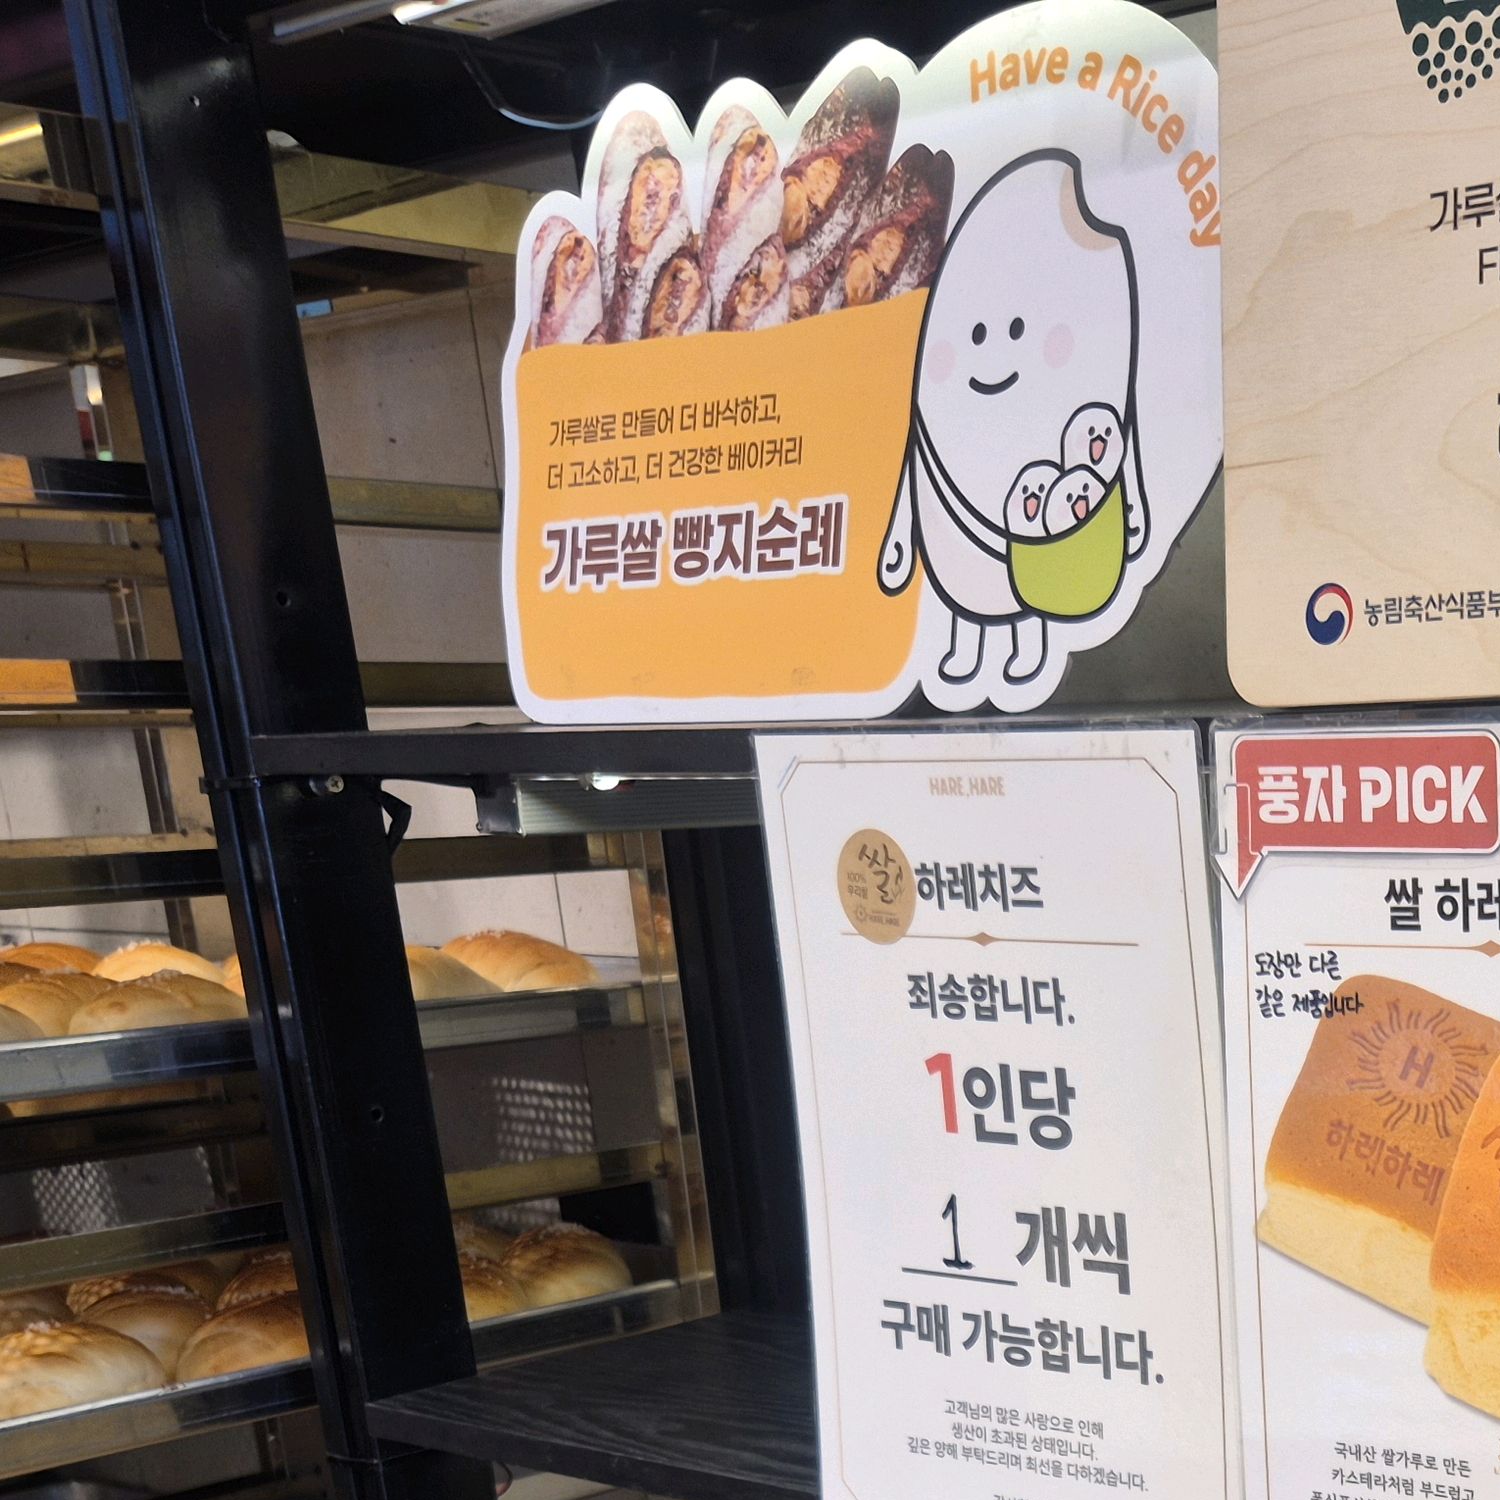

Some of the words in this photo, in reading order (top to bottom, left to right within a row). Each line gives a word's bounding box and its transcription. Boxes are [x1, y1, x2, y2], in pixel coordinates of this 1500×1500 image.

[970, 46, 1069, 103] Have
[1078, 55, 1101, 87] a
[1107, 54, 1186, 154] Rice
[1177, 149, 1221, 248] day
[549, 411, 617, 447] 가루쌀로
[621, 403, 675, 439] 만들어
[680, 405, 698, 433] 더
[702, 393, 781, 430] 바삭하고,
[547, 462, 564, 490] 더
[566, 454, 641, 489] 고소하고,
[645, 453, 663, 480] 더
[667, 443, 722, 478] 건강한
[726, 436, 803, 474] 베이커리
[544, 521, 661, 586] 가루쌀
[673, 502, 844, 578] 빵지순례
[1257, 765, 1346, 825] 풍자
[1360, 764, 1488, 823] PICK
[914, 861, 1044, 913] 하레치즈
[1384, 876, 1423, 932] 쌀
[1255, 949, 1302, 979] 도장만
[1309, 950, 1342, 981] 다른
[907, 972, 1076, 1026] 죄송합니다.
[1255, 984, 1286, 1019] 같은
[1291, 989, 1365, 1019] 제품입니다
[1400, 1044, 1434, 1087] H
[925, 1051, 1076, 1150] 1인당
[942, 1193, 975, 1270] 1
[1015, 1206, 1132, 1296] 개씩
[880, 1298, 952, 1357] 구매
[962, 1309, 1165, 1386] 가능합니다.
[944, 1400, 993, 1421] 고객님의
[995, 1405, 1020, 1425] 많은
[1024, 1412, 1074, 1433] 사랑으로
[1077, 1418, 1104, 1439] 인해
[951, 1422, 988, 1443] 생산이
[990, 1427, 1028, 1449] 초과된
[1030, 1434, 1099, 1461] 상태입니다.
[907, 1436, 931, 1455] 깊은
[934, 1440, 958, 1460] 양해
[961, 1445, 1023, 1472] 부탁드리며
[1026, 1456, 1063, 1478] 최선을
[1066, 1463, 1149, 1492] 다하겠습니다.
[1331, 1467, 1415, 1497] 카스테라처럼
[1333, 1441, 1378, 1466] 국내산
[1381, 1446, 1439, 1472] 쌀가루로
[1442, 1455, 1472, 1479] 만든
